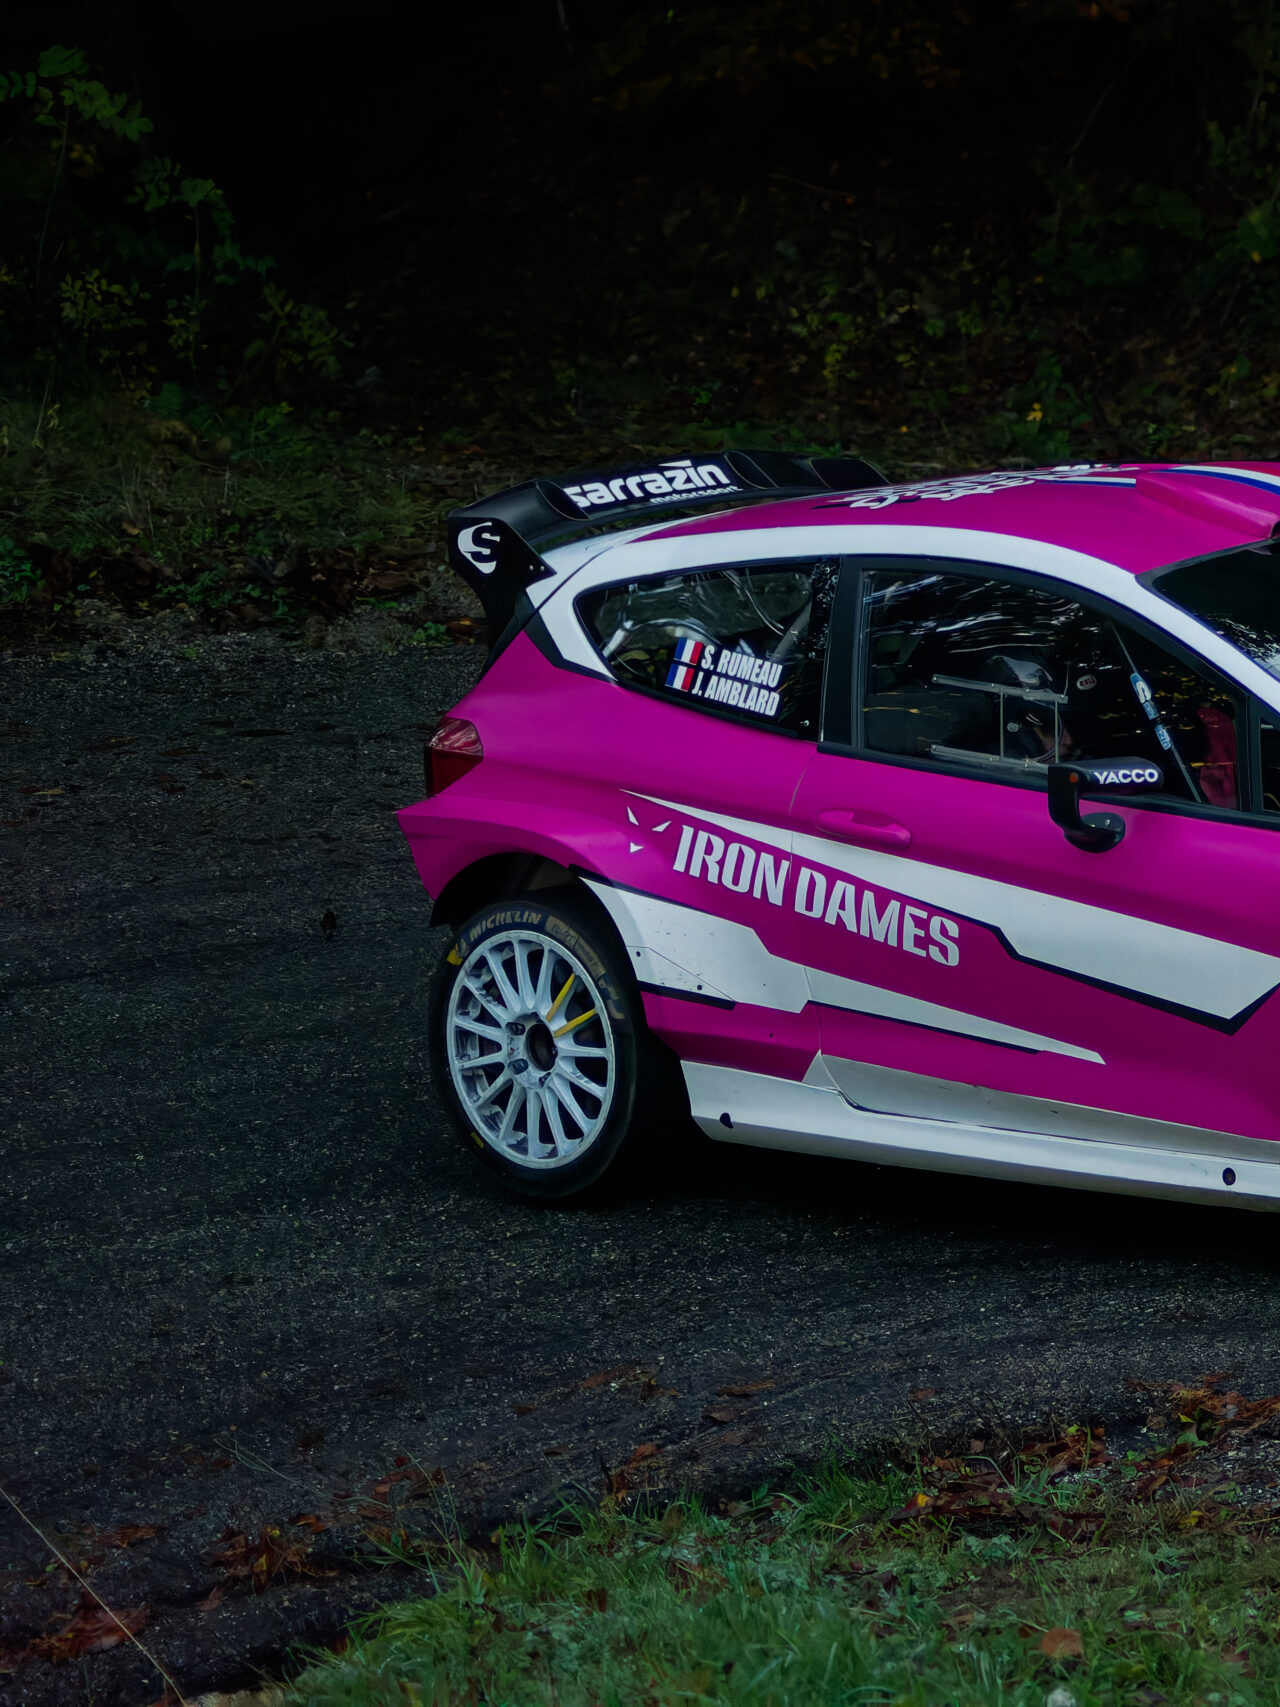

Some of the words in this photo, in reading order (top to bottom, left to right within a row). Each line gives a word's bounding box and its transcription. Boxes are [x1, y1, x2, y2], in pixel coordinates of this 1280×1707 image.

[563, 459, 731, 508] sarrazin
[650, 486, 744, 504] motorsport
[700, 644, 716, 671] S.
[716, 649, 783, 689] RUMEAU
[691, 671, 705, 697] J.
[703, 675, 781, 717] AMBLARD
[1093, 768, 1159, 785] YACCO
[672, 824, 790, 907] IRON
[794, 866, 960, 967] DAMES
[469, 910, 543, 943] MICHELIN
